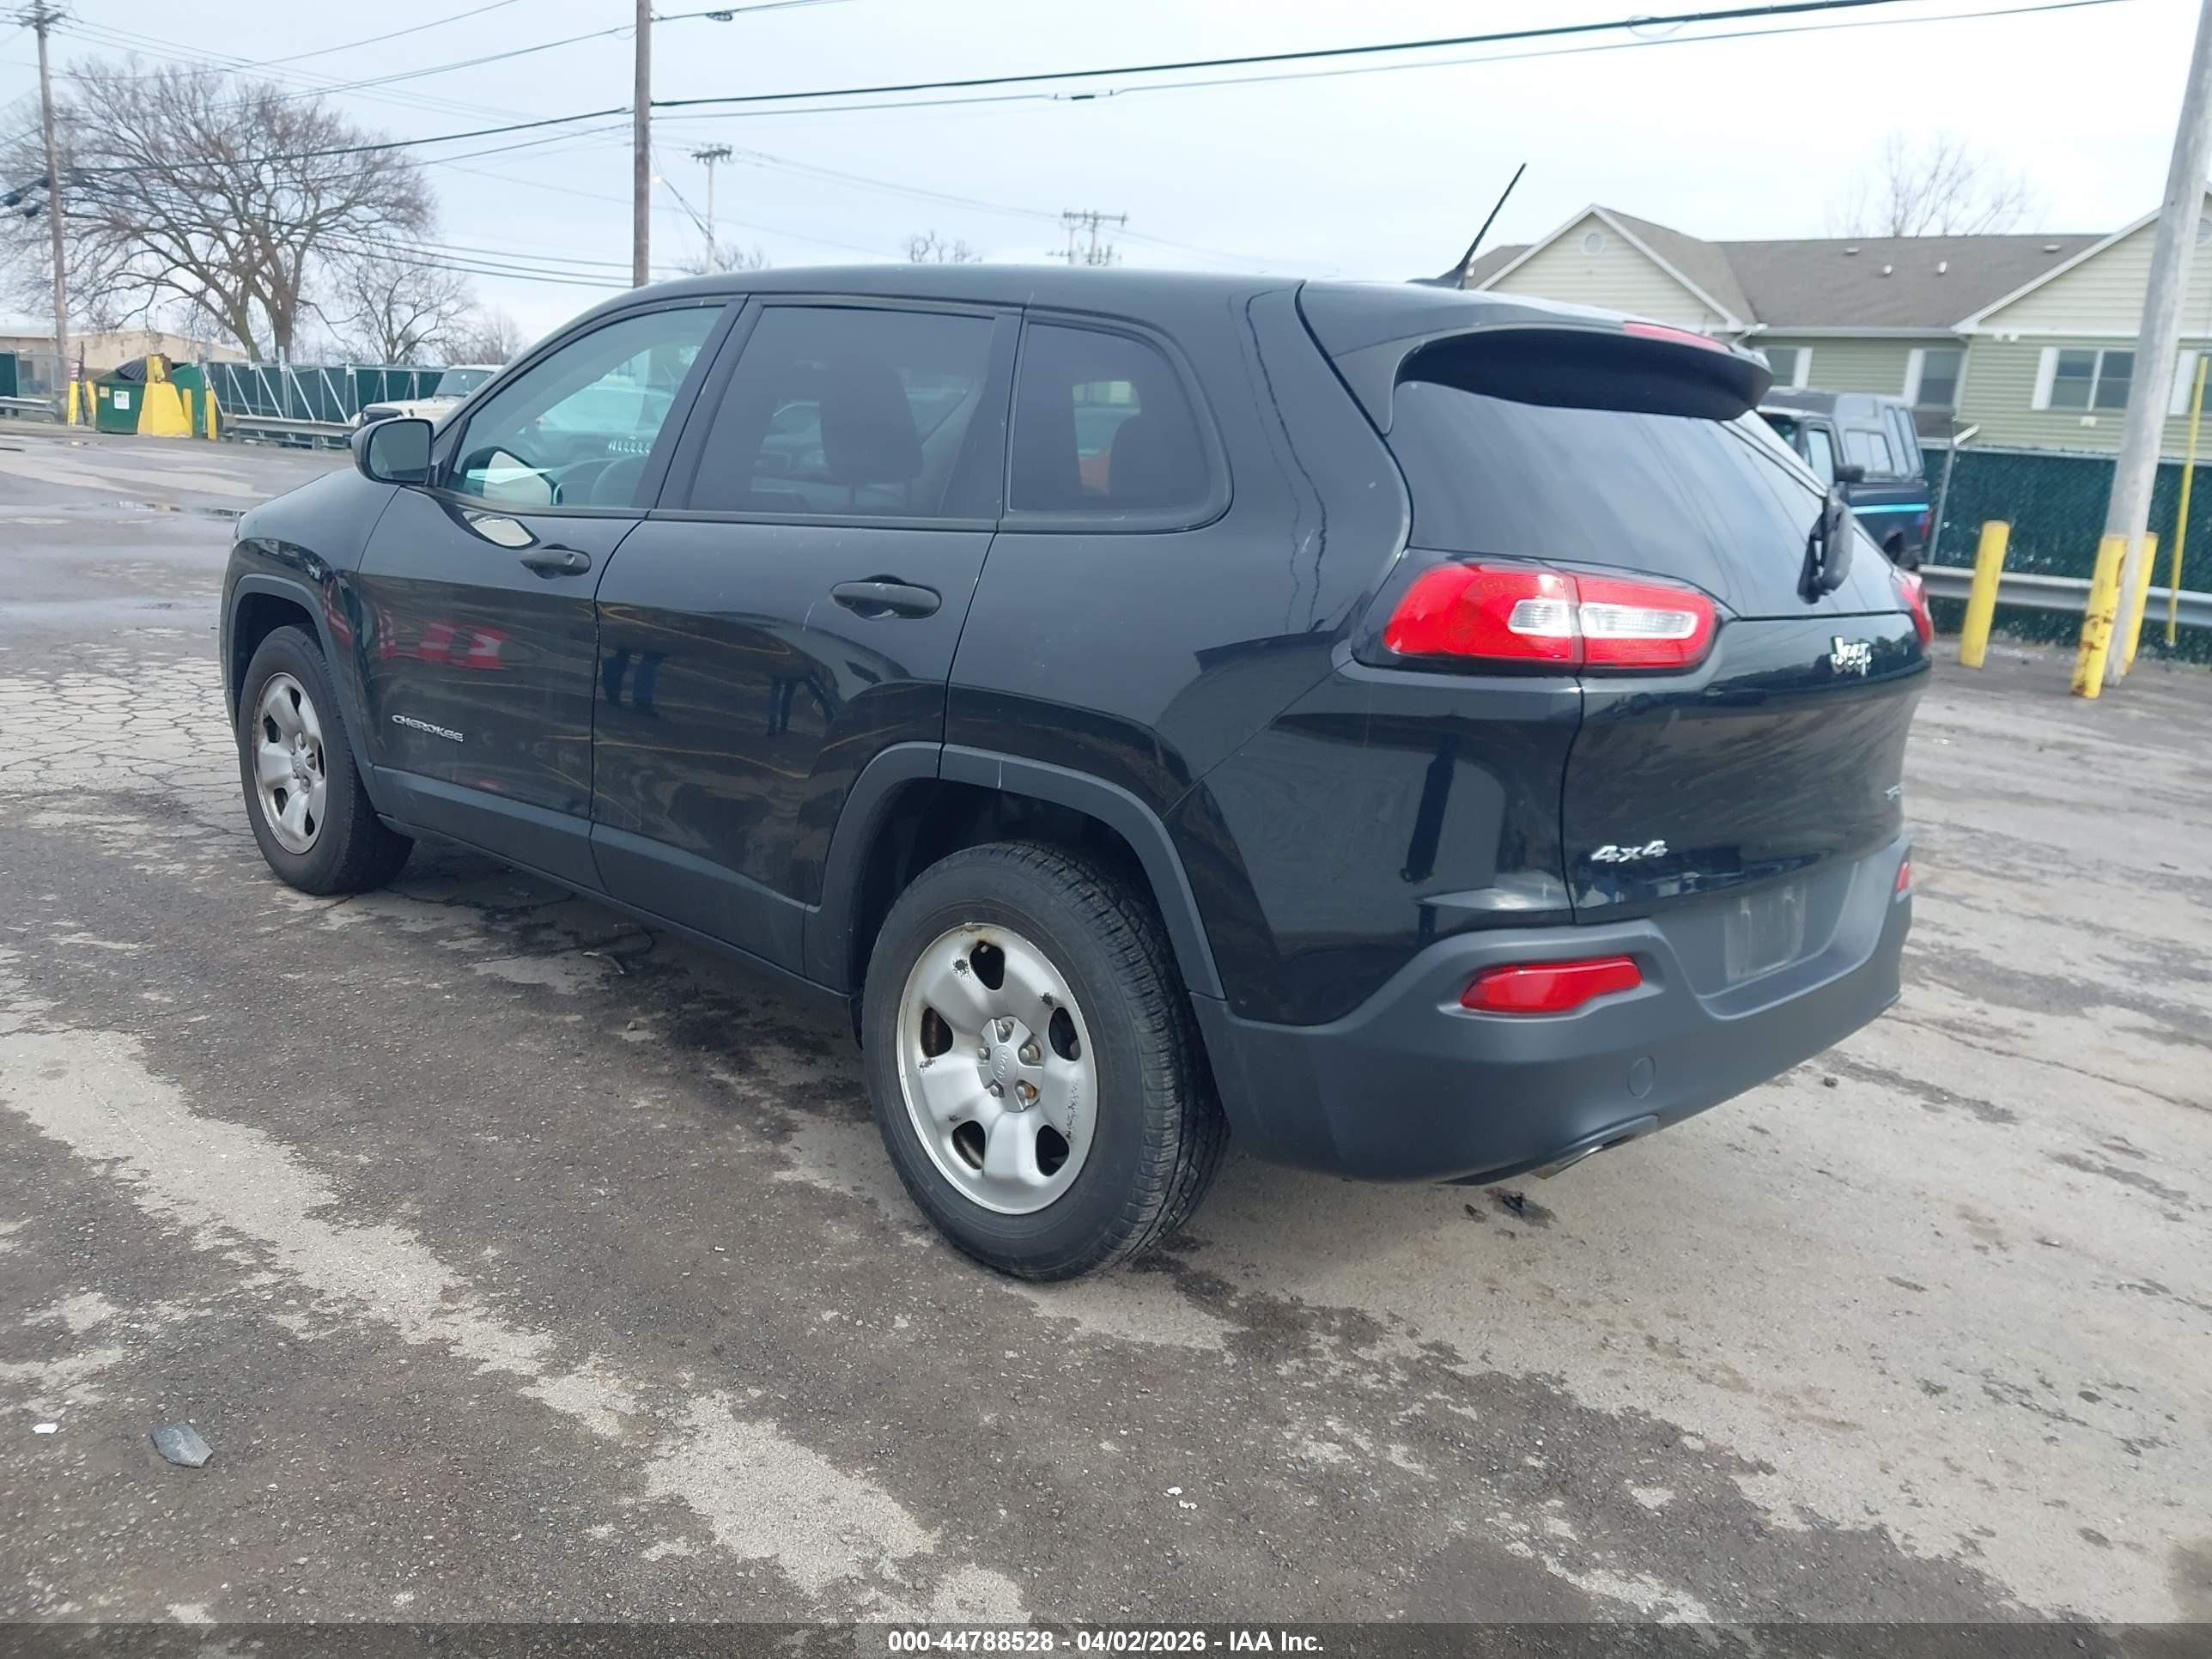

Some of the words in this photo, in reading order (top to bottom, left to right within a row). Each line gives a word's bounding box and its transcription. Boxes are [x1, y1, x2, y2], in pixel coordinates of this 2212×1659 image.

[1830, 636, 1872, 676] Jeep
[392, 714, 464, 743] CHEROKEE
[996, 1052, 1009, 1079] Jeep
